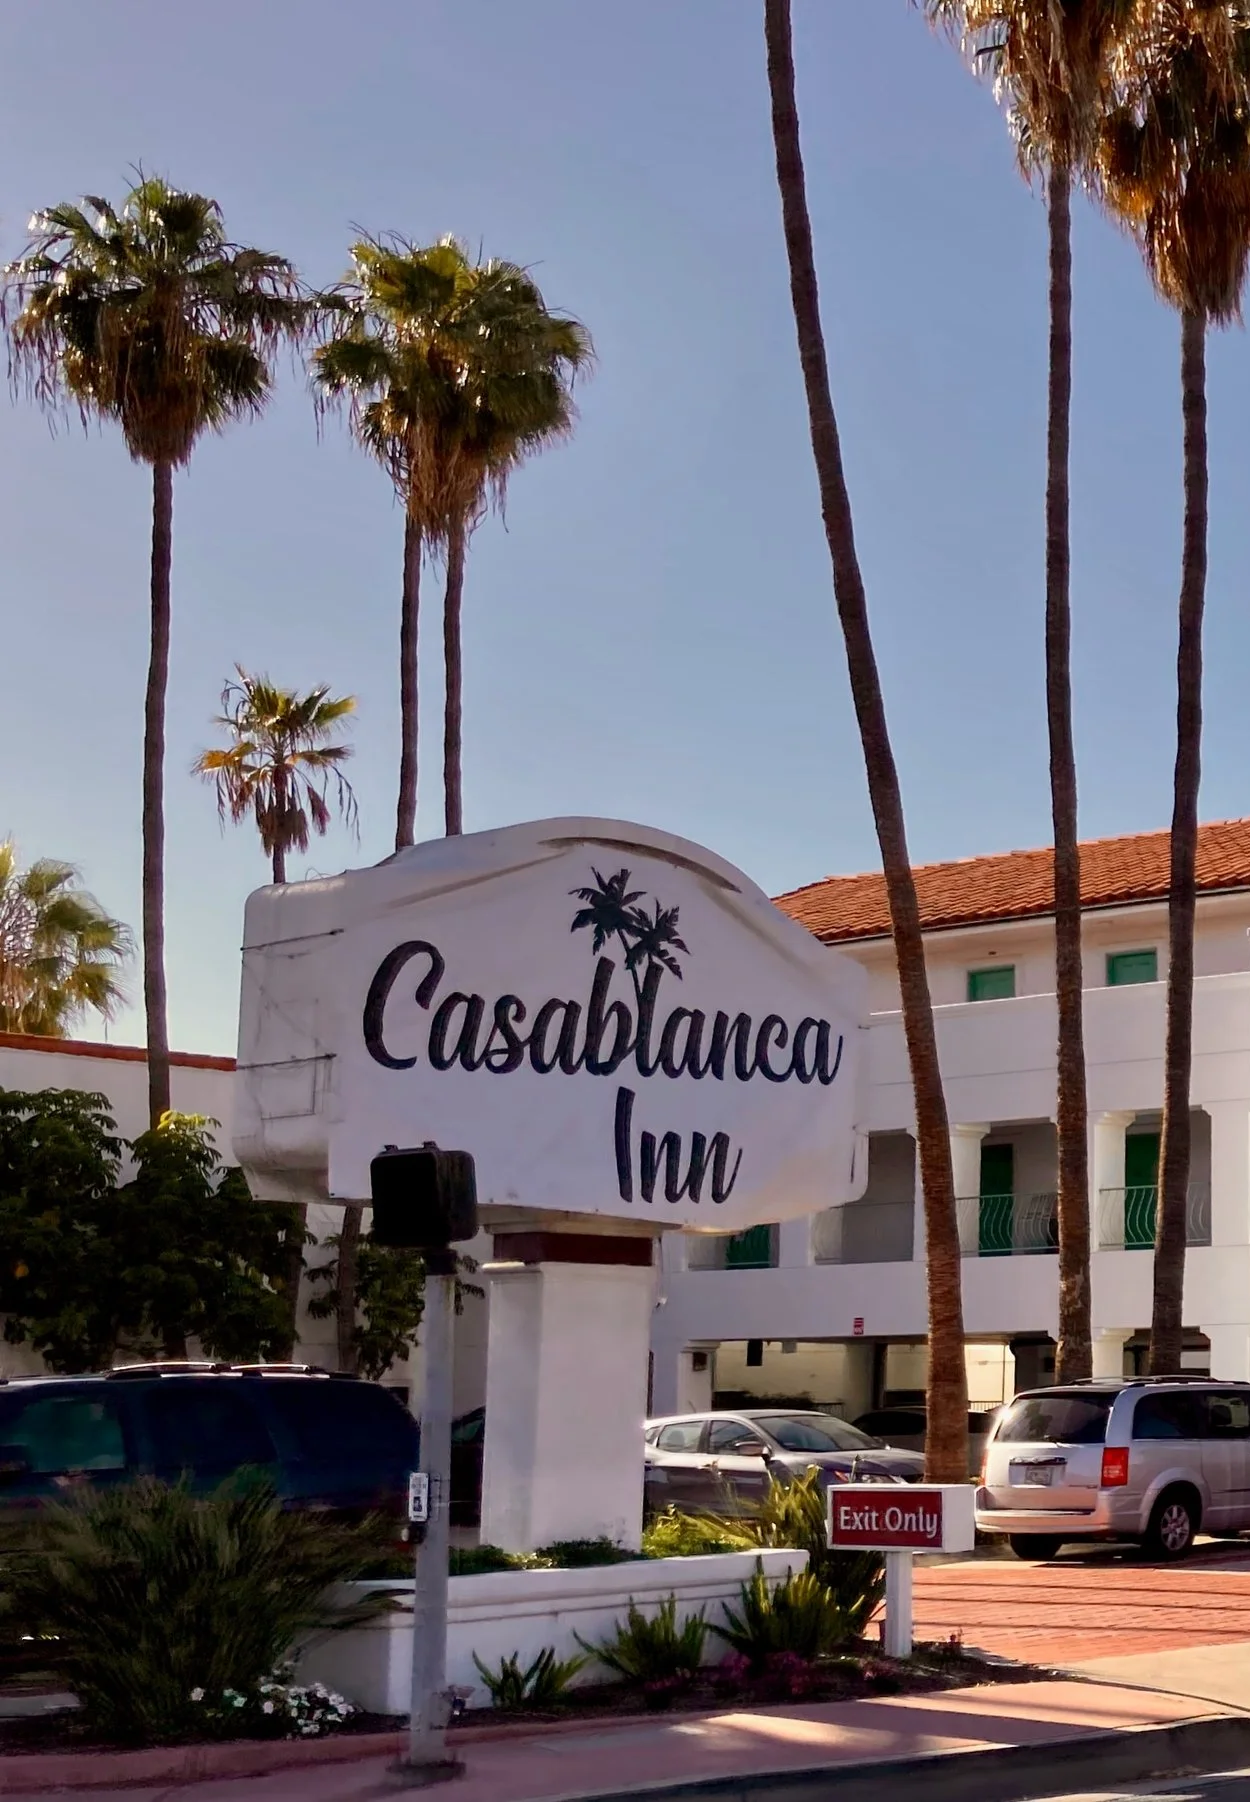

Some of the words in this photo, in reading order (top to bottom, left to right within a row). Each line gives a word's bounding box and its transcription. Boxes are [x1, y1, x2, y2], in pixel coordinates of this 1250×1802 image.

[362, 939, 843, 1086] Casablanca
[613, 1086, 743, 1205] Inn
[840, 1505, 880, 1531] Exit
[885, 1506, 938, 1539] Only
